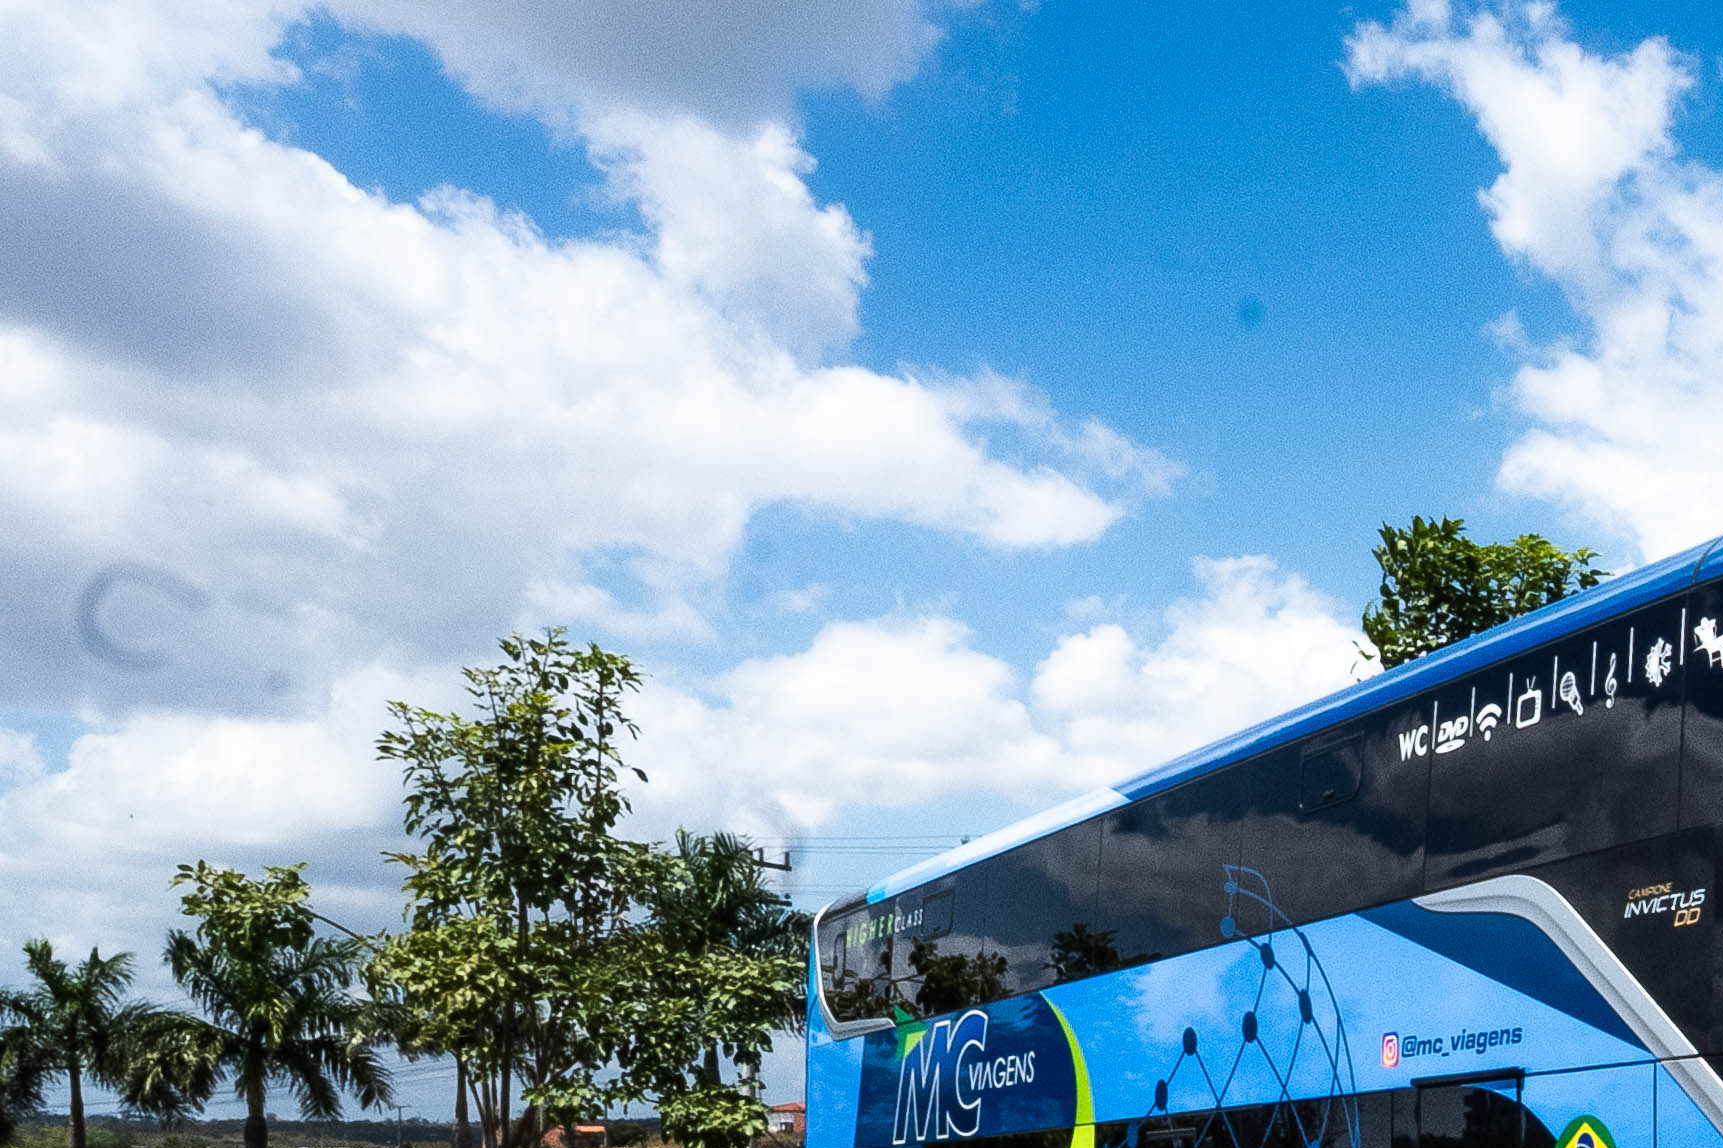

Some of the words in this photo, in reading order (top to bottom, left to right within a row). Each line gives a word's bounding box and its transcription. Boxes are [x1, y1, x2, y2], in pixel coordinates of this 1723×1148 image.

[1398, 725, 1429, 762] WC
[1437, 715, 1469, 743] DVD
[1623, 888, 1706, 919] INVICTUS
[1673, 907, 1701, 928] DD
[1401, 1027, 1523, 1058] @mc_viagens
[892, 1009, 989, 1146] MC
[969, 1051, 1036, 1091] VIAGENS
